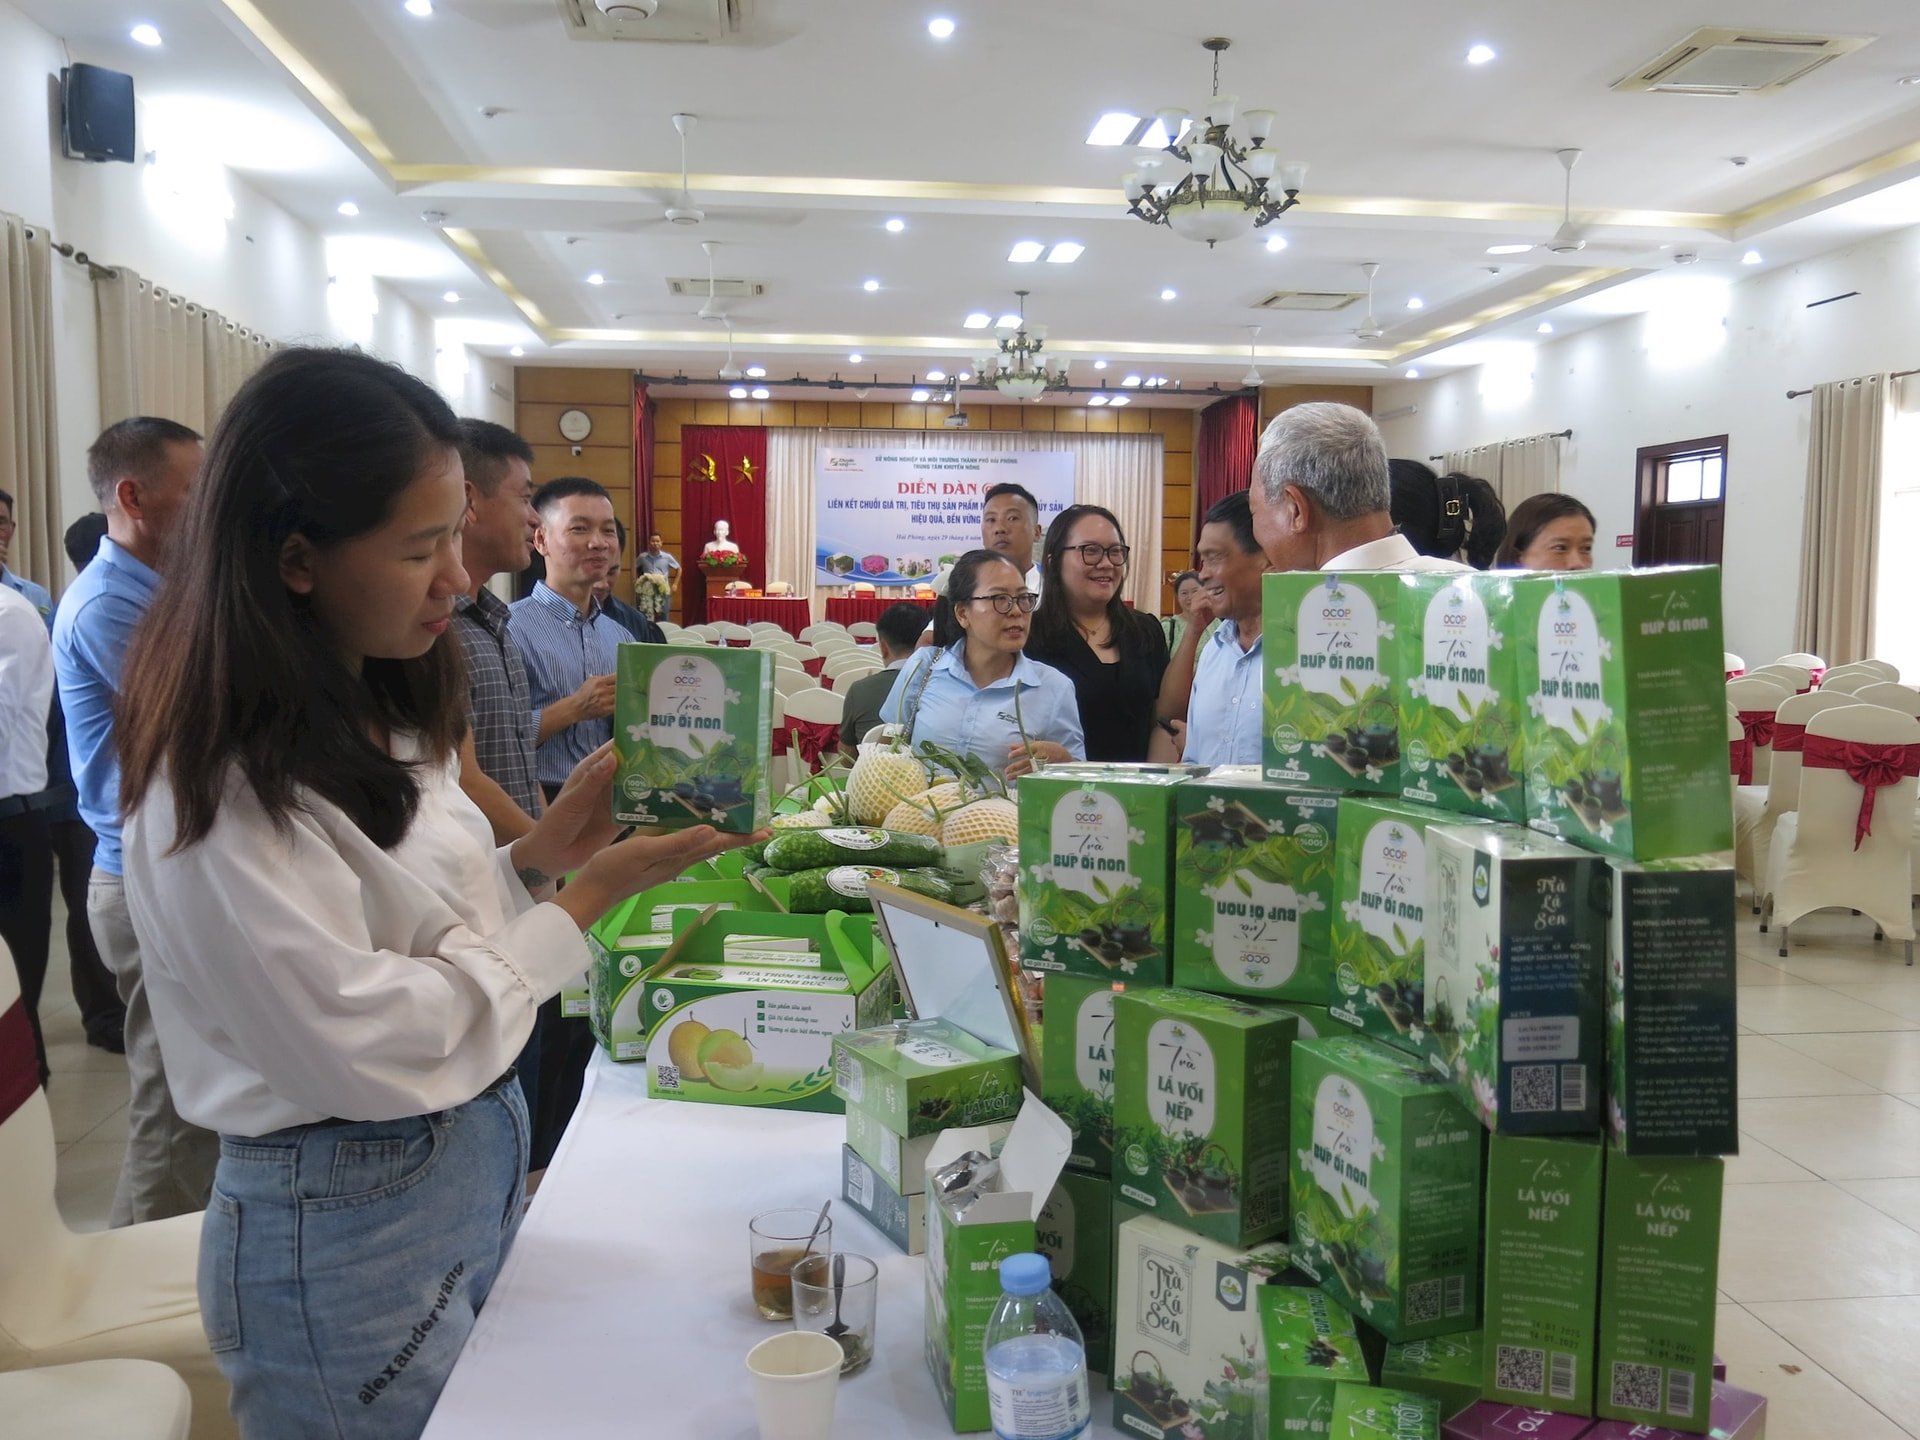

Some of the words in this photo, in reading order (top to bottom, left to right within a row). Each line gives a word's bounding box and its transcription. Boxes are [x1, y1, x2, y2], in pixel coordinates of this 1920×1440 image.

[943, 480, 977, 495] ĐÀN
[828, 498, 843, 509] LIÊN
[845, 498, 858, 509] KẾT
[860, 498, 880, 509] CHUỖI
[882, 499, 894, 509] GIÁ
[911, 500, 926, 510] TIÊU
[927, 501, 940, 511] THỤ
[942, 499, 956, 510] SẢN
[958, 499, 978, 511] PHẨM
[1049, 500, 1063, 511] SẢN
[911, 514, 927, 525] HIỆU
[946, 513, 960, 524] BỀN
[962, 513, 981, 524] VỮNG
[1322, 608, 1352, 618] OCOP
[1443, 614, 1467, 626] OCOP
[1554, 622, 1577, 634] OCOP
[1316, 631, 1358, 652] Trà
[1438, 639, 1472, 662] Trà
[1550, 651, 1583, 676] Trà
[674, 676, 702, 685] OCOP
[667, 695, 708, 714] Trà
[1075, 813, 1103, 823] OCOP
[1069, 834, 1110, 854] Trà
[1382, 846, 1408, 861] OCOP
[1376, 871, 1412, 896] Trà
[1536, 878, 1567, 894] Trà
[1534, 912, 1568, 931] Sen
[1089, 1045, 1106, 1062] LÁ
[1158, 1043, 1202, 1073] Trà
[969, 1069, 1006, 1094] Trà
[1158, 1074, 1175, 1097] LÁ
[1178, 1080, 1204, 1103] VỐI
[1165, 1101, 1194, 1122] NẾP
[1326, 1124, 1357, 1155] Trà
[1520, 1159, 1570, 1183] Trà
[1639, 1173, 1692, 1197] Trà
[1518, 1188, 1537, 1202] LÁ
[1541, 1189, 1571, 1206] VỐI
[1528, 1206, 1559, 1222] NẾP
[1636, 1202, 1655, 1217] LÁ
[1660, 1203, 1692, 1222] VỐI
[1647, 1222, 1679, 1238] NẾP
[1147, 1259, 1184, 1299] Trà
[1159, 1292, 1183, 1316] Lá
[1146, 1302, 1183, 1337] Sen
